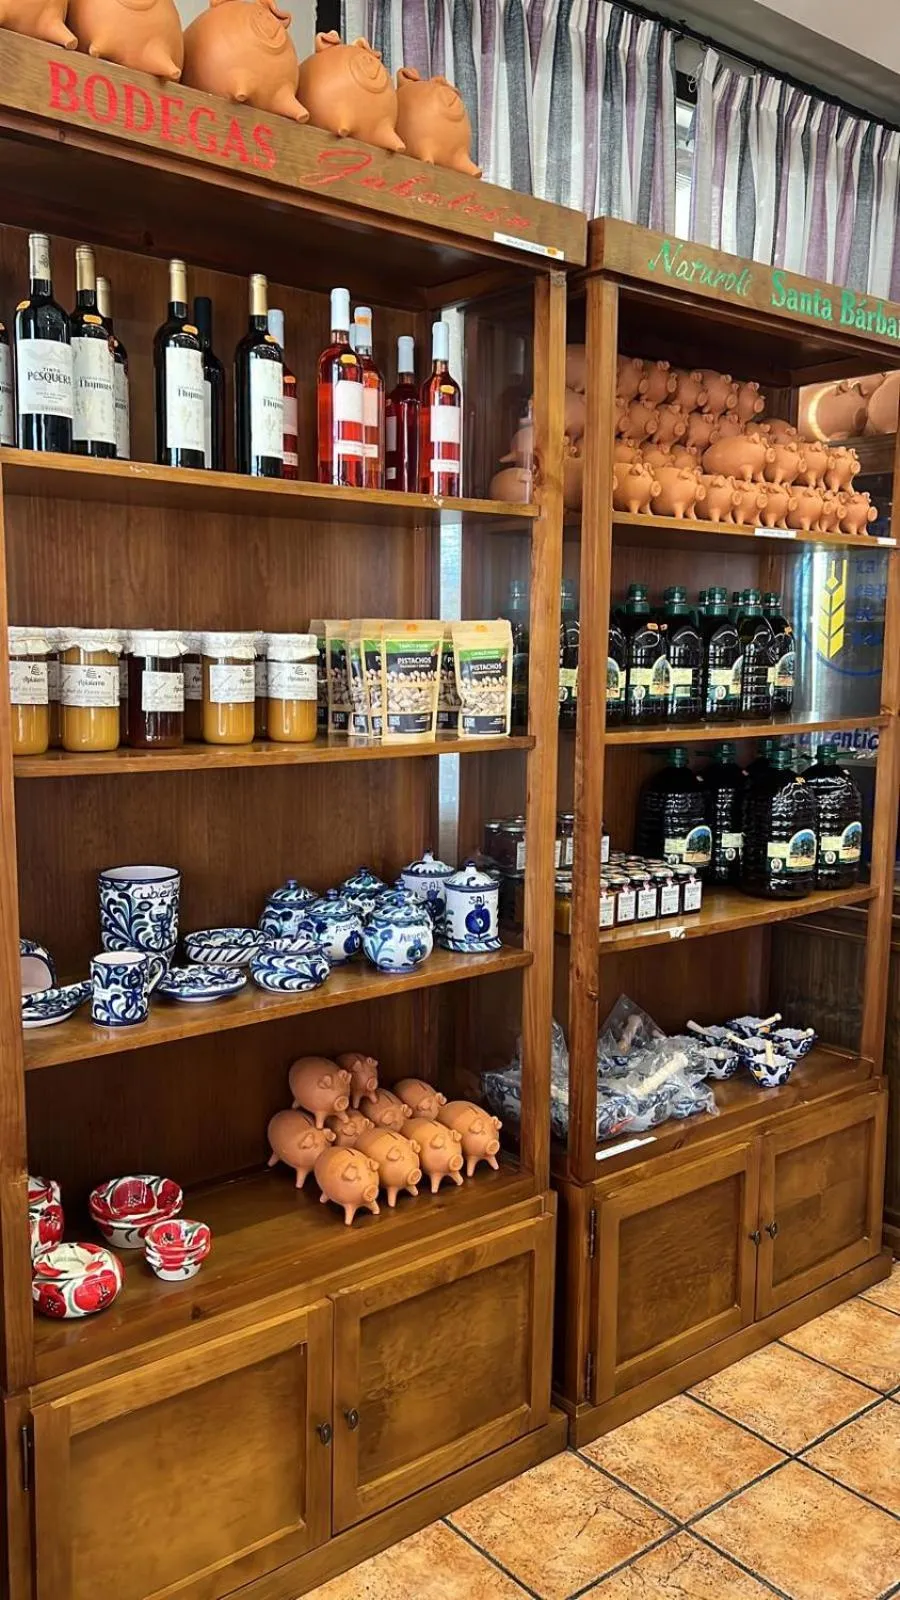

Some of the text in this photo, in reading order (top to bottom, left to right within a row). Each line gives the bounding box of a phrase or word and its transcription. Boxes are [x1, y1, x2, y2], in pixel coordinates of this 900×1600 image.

[48, 60, 277, 171] BODEGAS
[771, 271, 833, 321] Santa
[840, 290, 900, 339] Bárba
[27, 371, 71, 385] PESQUERA
[397, 656, 432, 664] PISTACHOS
[470, 662, 502, 671] PISTACHOS
[420, 880, 441, 891] SAL
[468, 894, 490, 906] SAL
